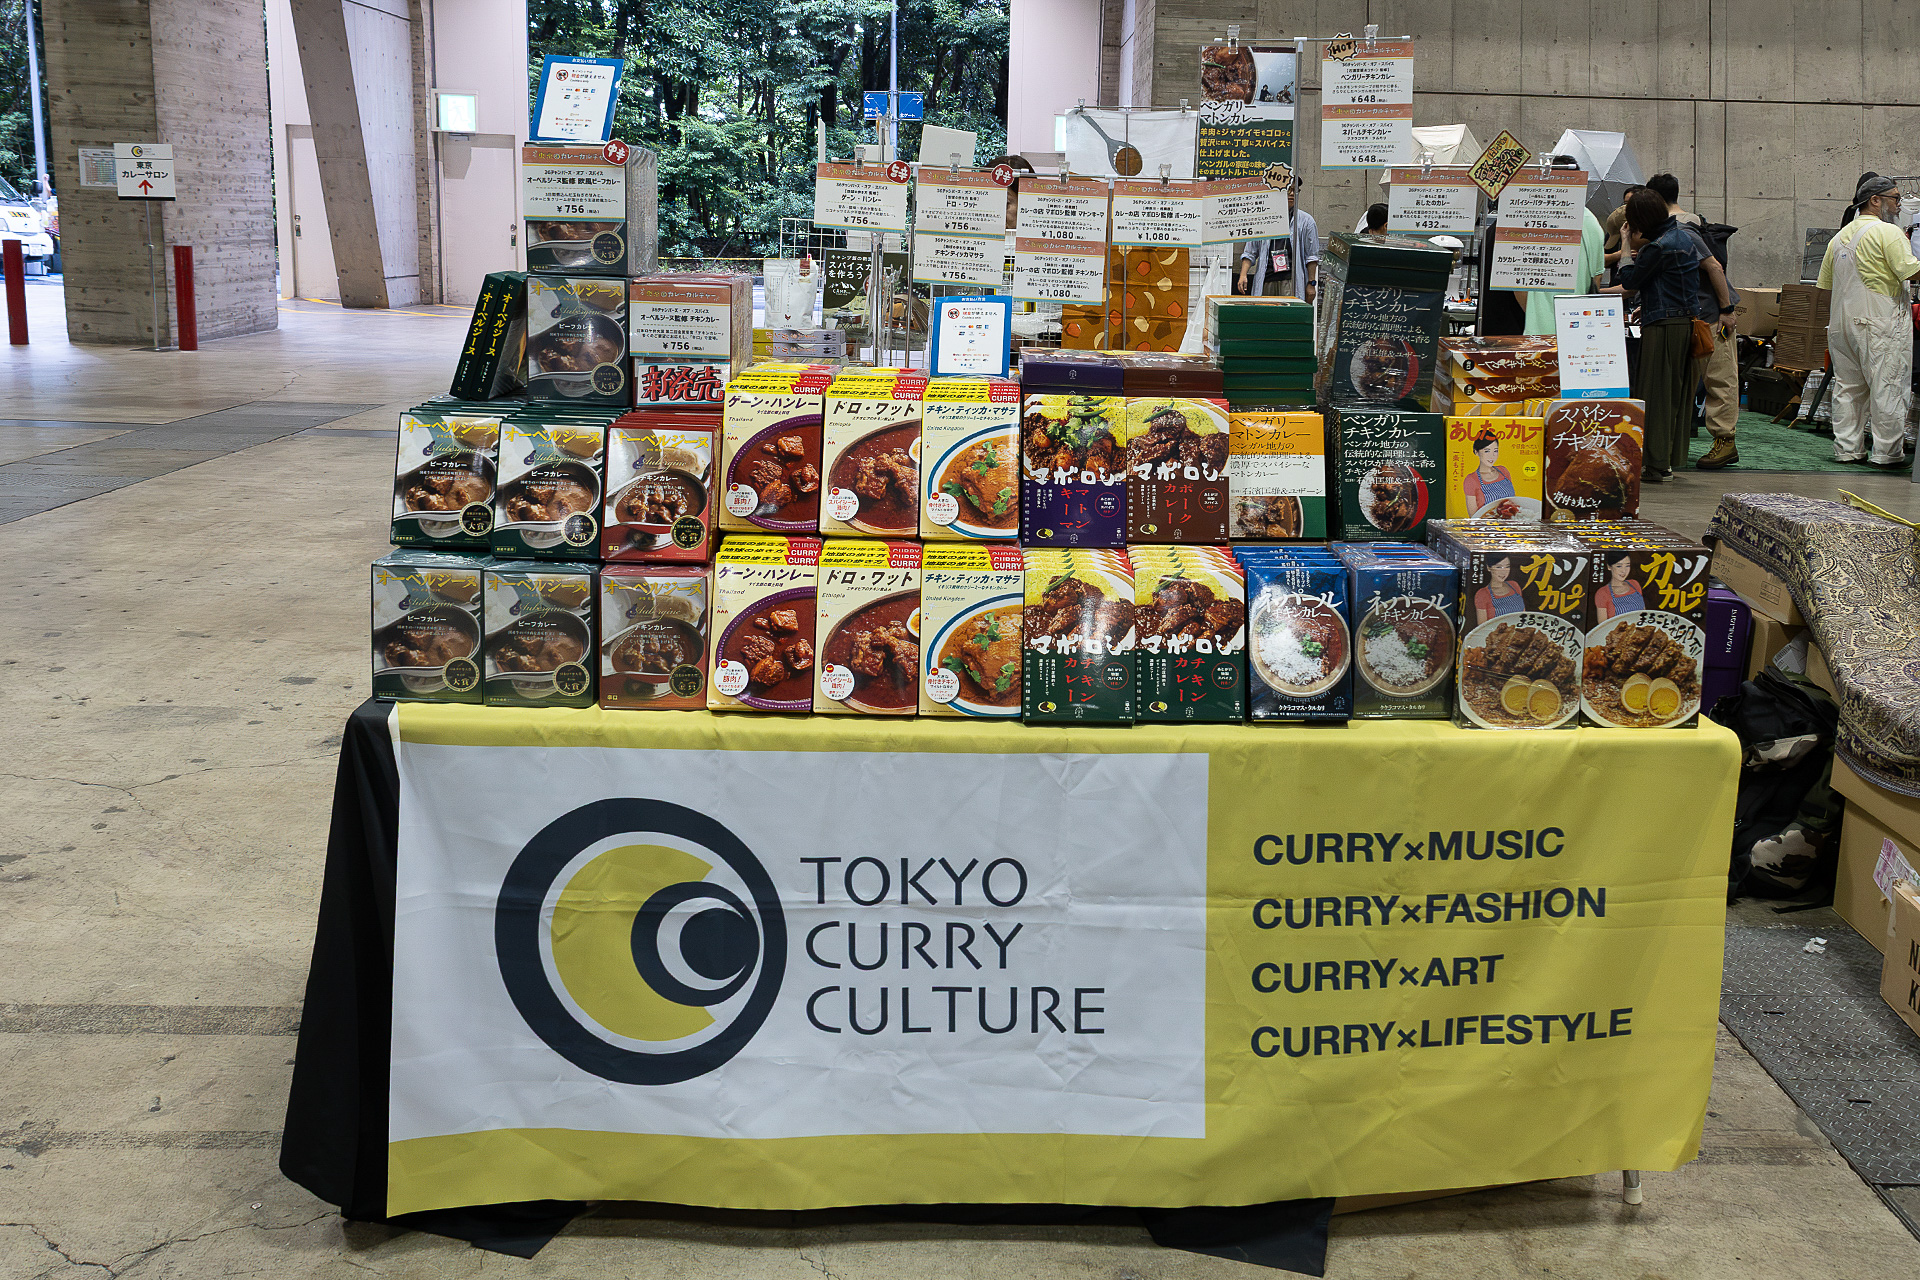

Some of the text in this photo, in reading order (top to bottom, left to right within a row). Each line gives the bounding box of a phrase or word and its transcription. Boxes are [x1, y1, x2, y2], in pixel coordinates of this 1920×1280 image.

[1332, 42, 1352, 54] HOT
[1351, 95, 1376, 103] ¥648
[1200, 101, 1257, 113] ベンガリー
[1200, 112, 1263, 124] マトンカレー
[1200, 128, 1291, 137] 羊肉とジャガイモをゴロッと
[1200, 149, 1250, 158] 仕上げました。
[1352, 155, 1376, 163] ¥648
[136, 161, 153, 170] 東京
[121, 171, 169, 179] カレーサロン
[527, 176, 576, 184] オーベルジーヌ監修
[1268, 171, 1289, 183] HOT
[842, 194, 881, 203] ゲーン・ハンレー
[1078, 210, 1104, 218] マトンキーマ
[1218, 207, 1270, 215] ベンガリーマトンカレー
[1042, 231, 1074, 239] ¥1,080
[1138, 233, 1169, 241] ¥1,080
[935, 250, 984, 259] チキンティッカマサラ
[829, 270, 862, 279] を作ろう
[1516, 278, 1546, 286] ¥1,296
[530, 281, 622, 298] オーベルジーヌ
[1039, 289, 1070, 298] ¥1,080
[1346, 288, 1419, 300] ベンガリー
[1345, 298, 1431, 313] チキンカレー
[465, 292, 492, 356] オーベルジーヌ
[640, 314, 688, 322] オーベルジーヌ監修
[1343, 313, 1408, 322] ベンガル地方の
[485, 293, 513, 356] オーベルジーヌ
[1342, 320, 1426, 334] 伝統的な調理による、
[1342, 331, 1430, 344] スパイスが華やかに香る
[641, 365, 725, 402] 新発売
[728, 396, 819, 409] ゲーン・ハンレー
[833, 400, 915, 417] ドロ・ワット
[926, 406, 1016, 415] チキン・ティッカ・マサラ
[1557, 404, 1621, 423] スパイシー
[404, 418, 498, 434] オーベルジーヌ
[1230, 416, 1304, 429] ベンガリー
[1343, 416, 1418, 428] ベンガリー
[1566, 421, 1611, 436] バター
[505, 426, 600, 444] オーベルジーヌ
[1231, 429, 1310, 440] マトンカレー
[1344, 428, 1431, 439] チキンカレー
[1450, 420, 1542, 442] あしたのカレー
[614, 433, 709, 449] オーベルジーヌ
[1230, 442, 1294, 450] ベンガル地方の
[1344, 441, 1409, 449] ベンガル地方の
[1553, 432, 1622, 451] チキンカレー
[1231, 451, 1315, 460] 伝統的な調理による、
[1344, 450, 1430, 458] 伝統的な調理による、
[1230, 461, 1310, 469] 濃厚でスパイシーな
[1345, 460, 1436, 468] スパイスが華やかに香る
[1030, 466, 1114, 486] マボロシ
[1133, 462, 1219, 481] マボロシ
[1231, 470, 1279, 478] マトンカレー
[1163, 483, 1178, 524] カレー
[1179, 483, 1194, 524] ポーク
[1553, 491, 1602, 509] 骨付き丸ごと!
[1060, 488, 1073, 528] キーマ
[1075, 489, 1090, 529] マトン
[468, 522, 485, 530] 大賞
[570, 532, 588, 541] 大賞
[718, 567, 814, 580] ゲーン・ハンレー
[1472, 554, 1480, 584] 一条もんこ
[1520, 553, 1588, 591] カツ
[1592, 553, 1600, 583] 一条もんこ
[1640, 552, 1708, 590] カツ
[376, 570, 477, 588] オーベルジーヌ
[826, 570, 913, 586] ドロ・ワット
[925, 573, 1020, 584] チキン・ティッカ・マサラ
[488, 577, 587, 593] オーベルジーヌ
[604, 580, 703, 596] オーベルジーヌ
[1258, 588, 1344, 612] ネパール
[1366, 590, 1452, 616] ネパール
[1272, 607, 1332, 619] チキンカレー
[1381, 610, 1440, 621] チキンカレー
[1031, 634, 1122, 656] マボロシ
[1141, 634, 1232, 655] マボロシ
[453, 678, 470, 686] 大賞
[1064, 658, 1079, 702] カレー
[1081, 658, 1096, 702] チキン
[1174, 657, 1190, 702] カレー
[1191, 658, 1207, 702] チキン
[563, 682, 580, 691] 大賞
[1253, 827, 1565, 865] CURRY×MUSIC
[800, 856, 1028, 907] TOKYO
[1252, 888, 1606, 929] CURRY×FASHION
[806, 921, 1024, 970] CURRY
[1252, 954, 1504, 993] CURRY×ART
[806, 986, 1104, 1035] CULTURE
[1250, 1008, 1633, 1058] CURRY×LIFESTYLE
